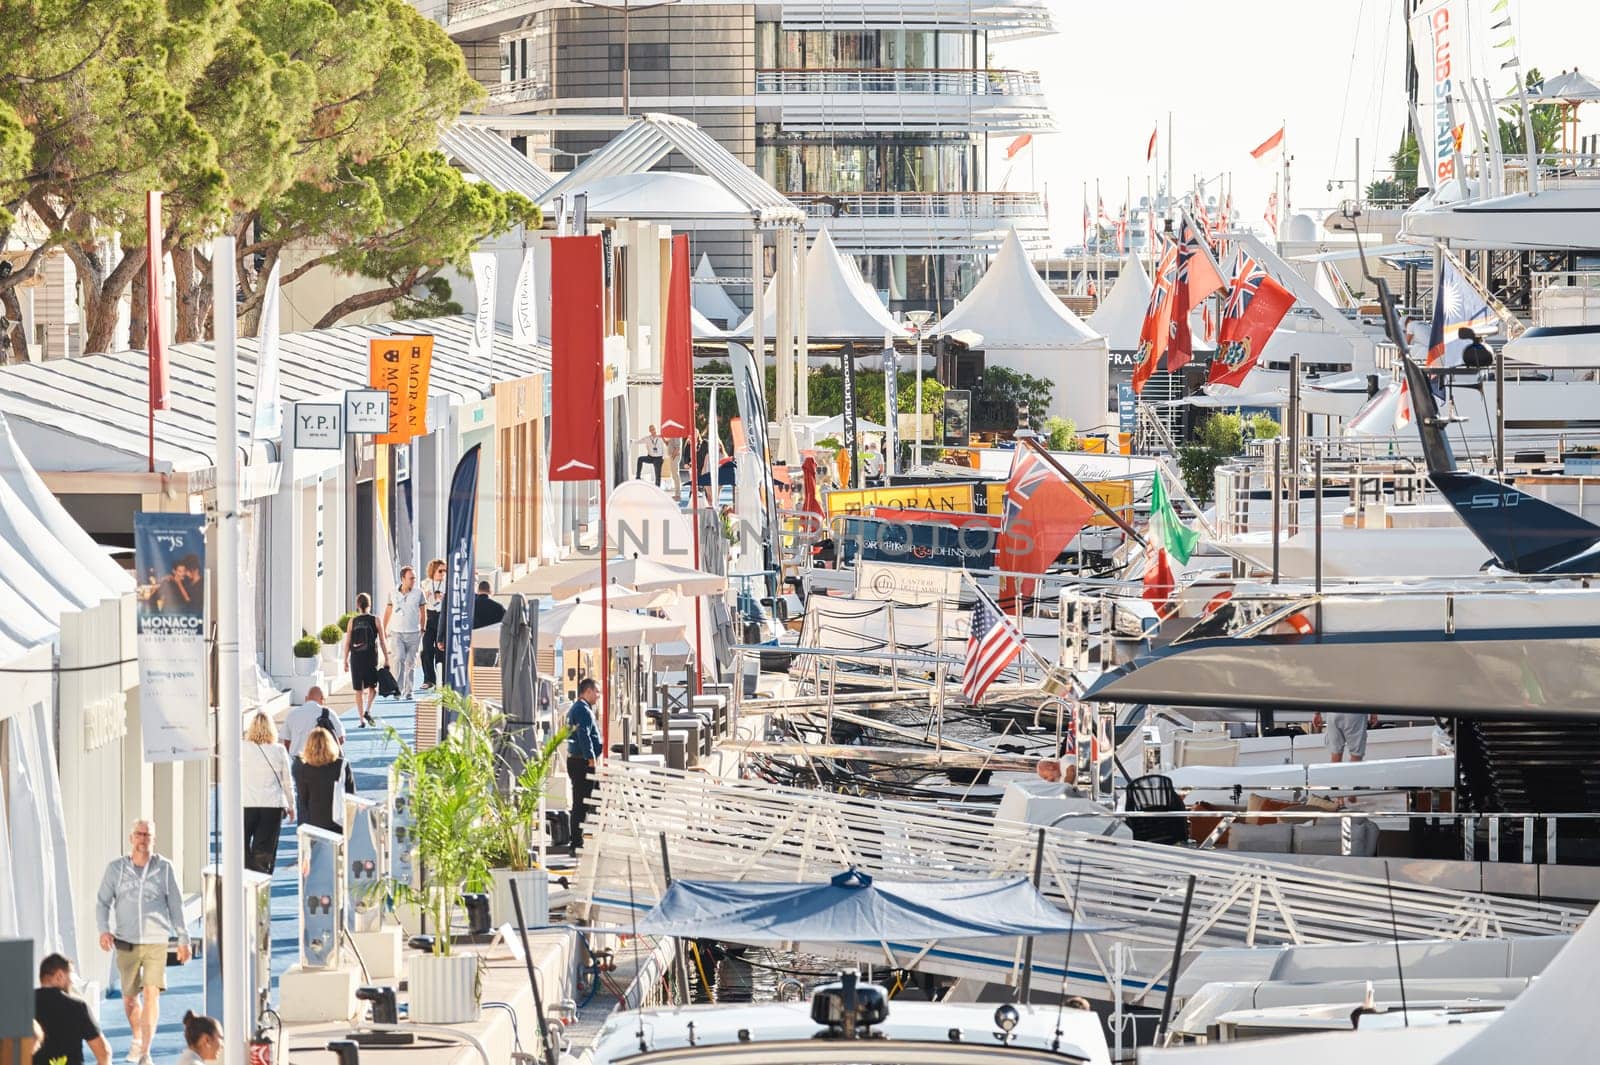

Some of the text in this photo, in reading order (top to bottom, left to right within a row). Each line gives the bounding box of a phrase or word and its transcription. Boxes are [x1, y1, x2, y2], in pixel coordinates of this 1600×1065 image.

[408, 363, 419, 426] MORAN
[929, 546, 980, 559] JOHNSON
[141, 616, 199, 628] MONACO
